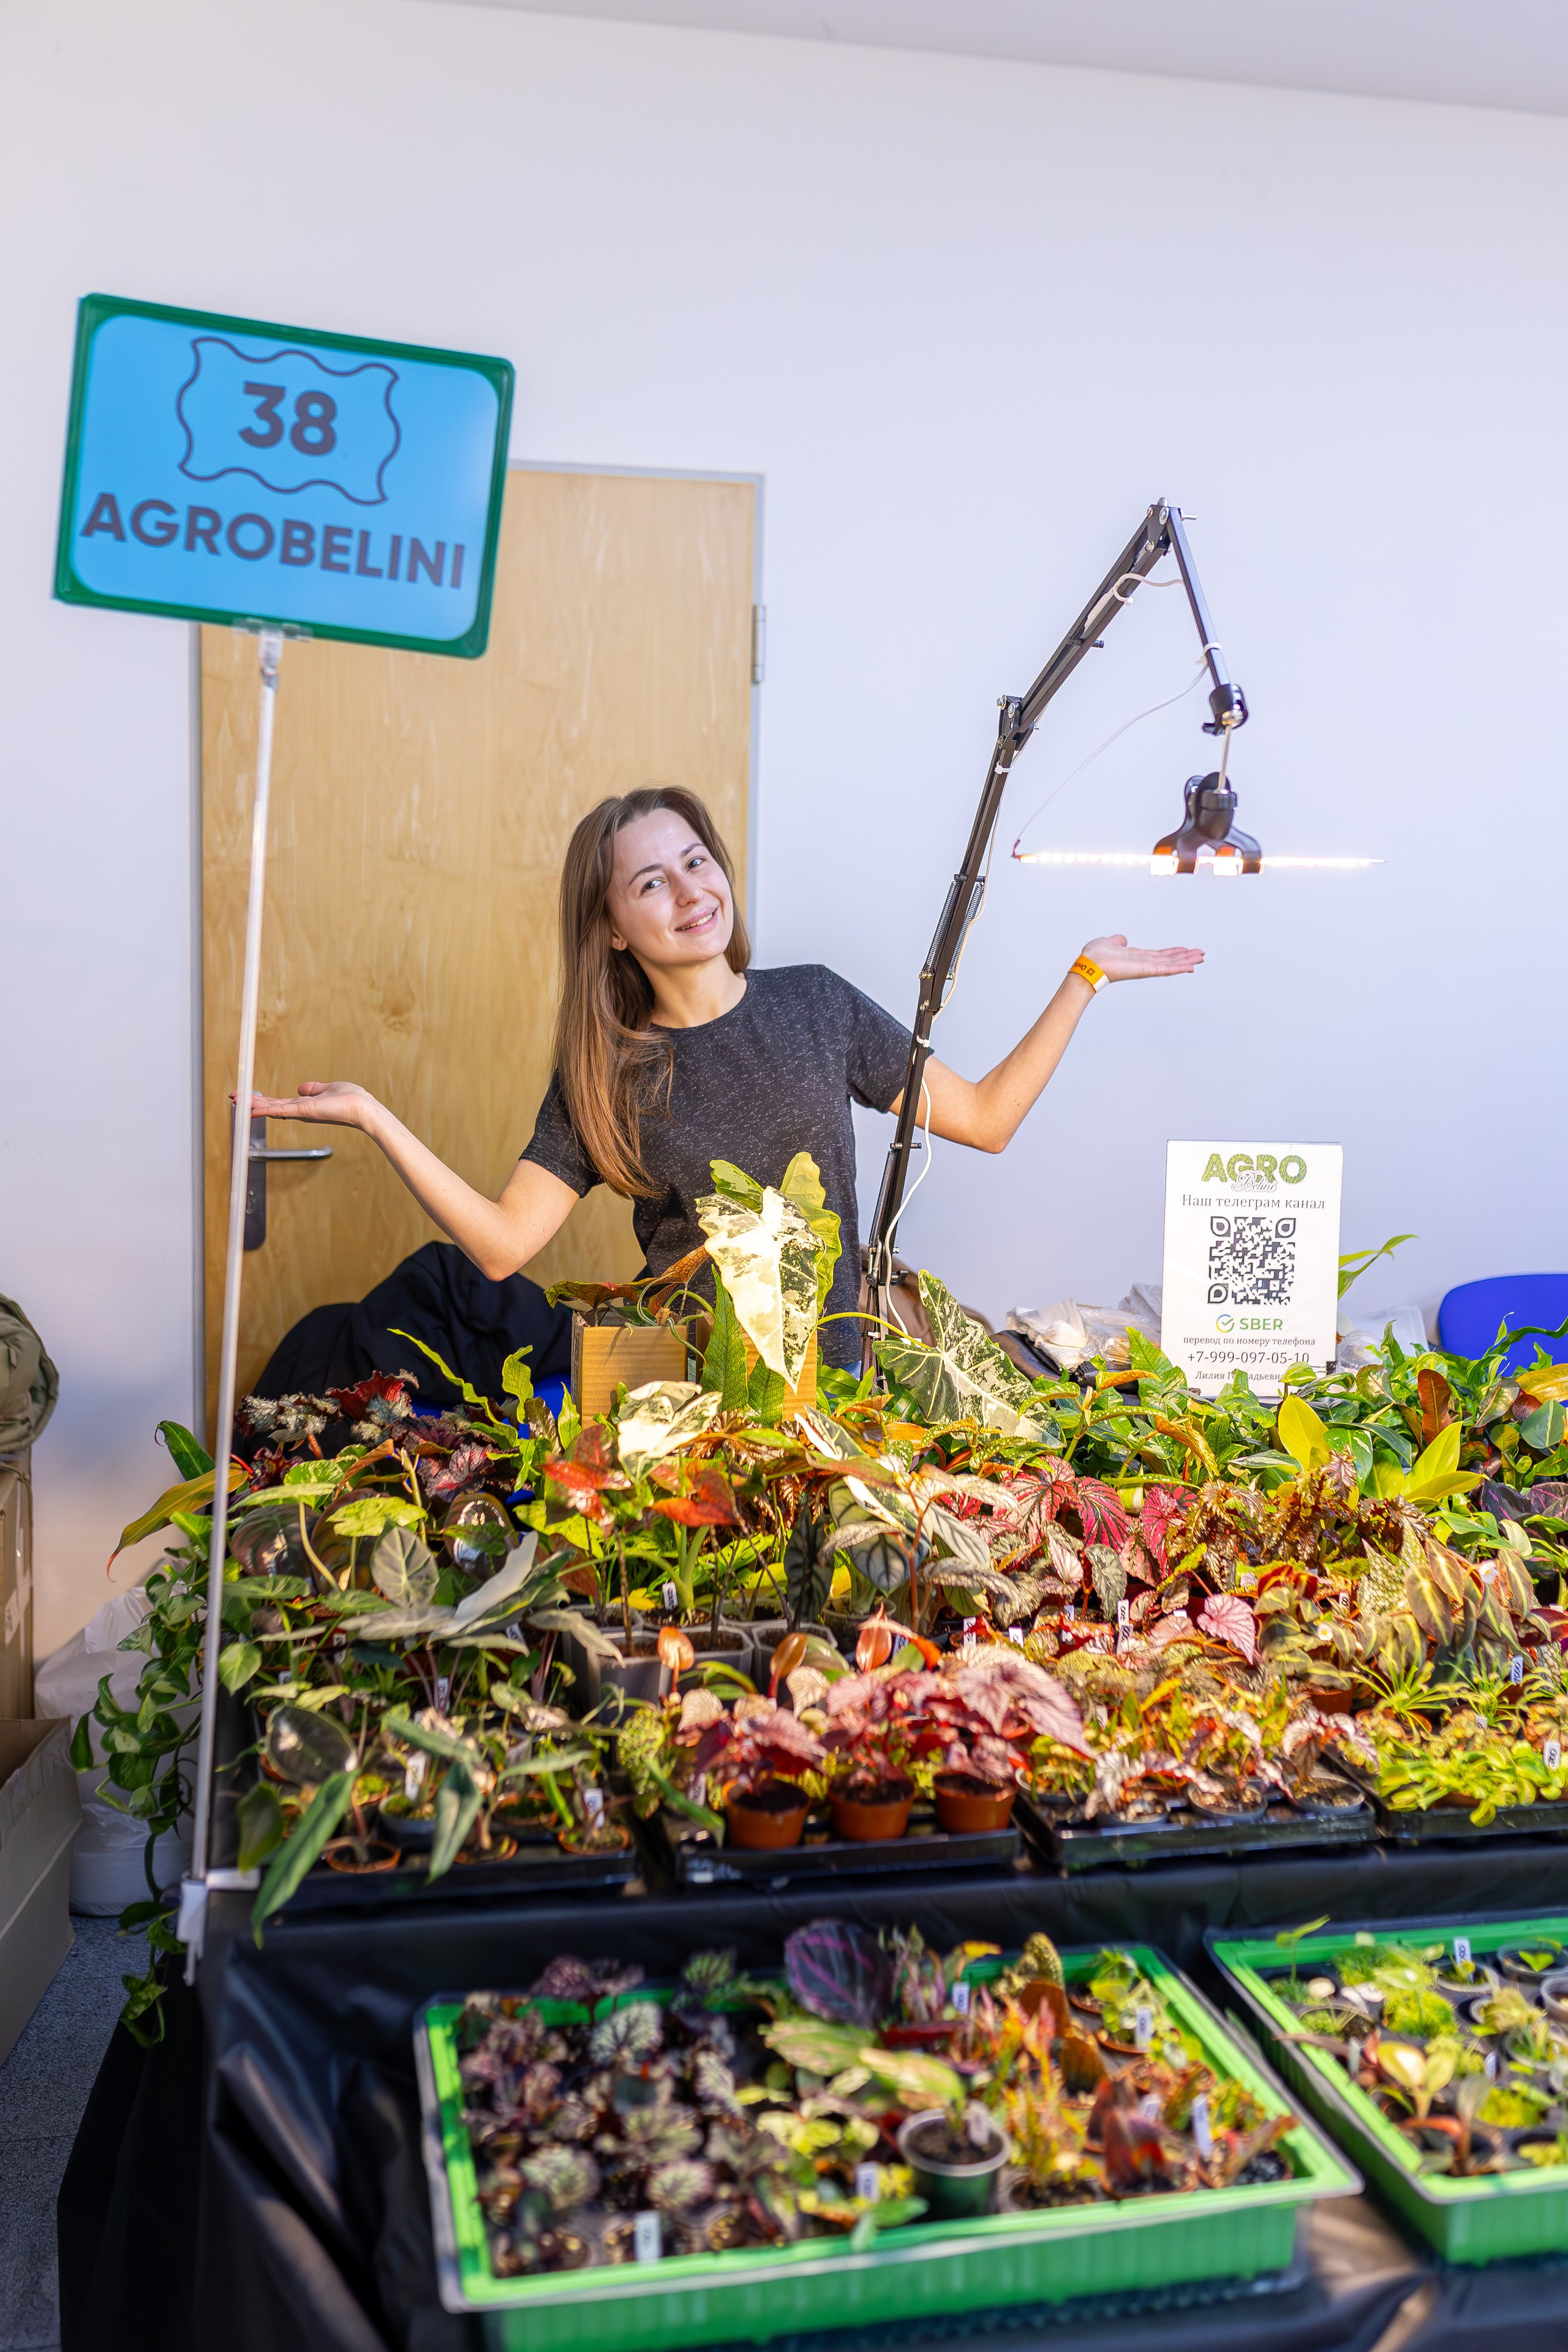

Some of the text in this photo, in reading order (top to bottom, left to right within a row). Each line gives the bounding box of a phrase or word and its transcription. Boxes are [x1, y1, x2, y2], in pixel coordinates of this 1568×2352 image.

[238, 380, 337, 456] 38
[80, 492, 466, 589] AGROBELINI
[1201, 1153, 1307, 1185] AGRO
[1182, 1194, 1325, 1211] Наш телеграм канал
[1239, 1317, 1283, 1330] SBER
[1183, 1337, 1221, 1346] перевод
[1237, 1338, 1270, 1346] номеру
[1272, 1338, 1316, 1347] телефона
[1188, 1351, 1310, 1364] +7-999-097-05-10
